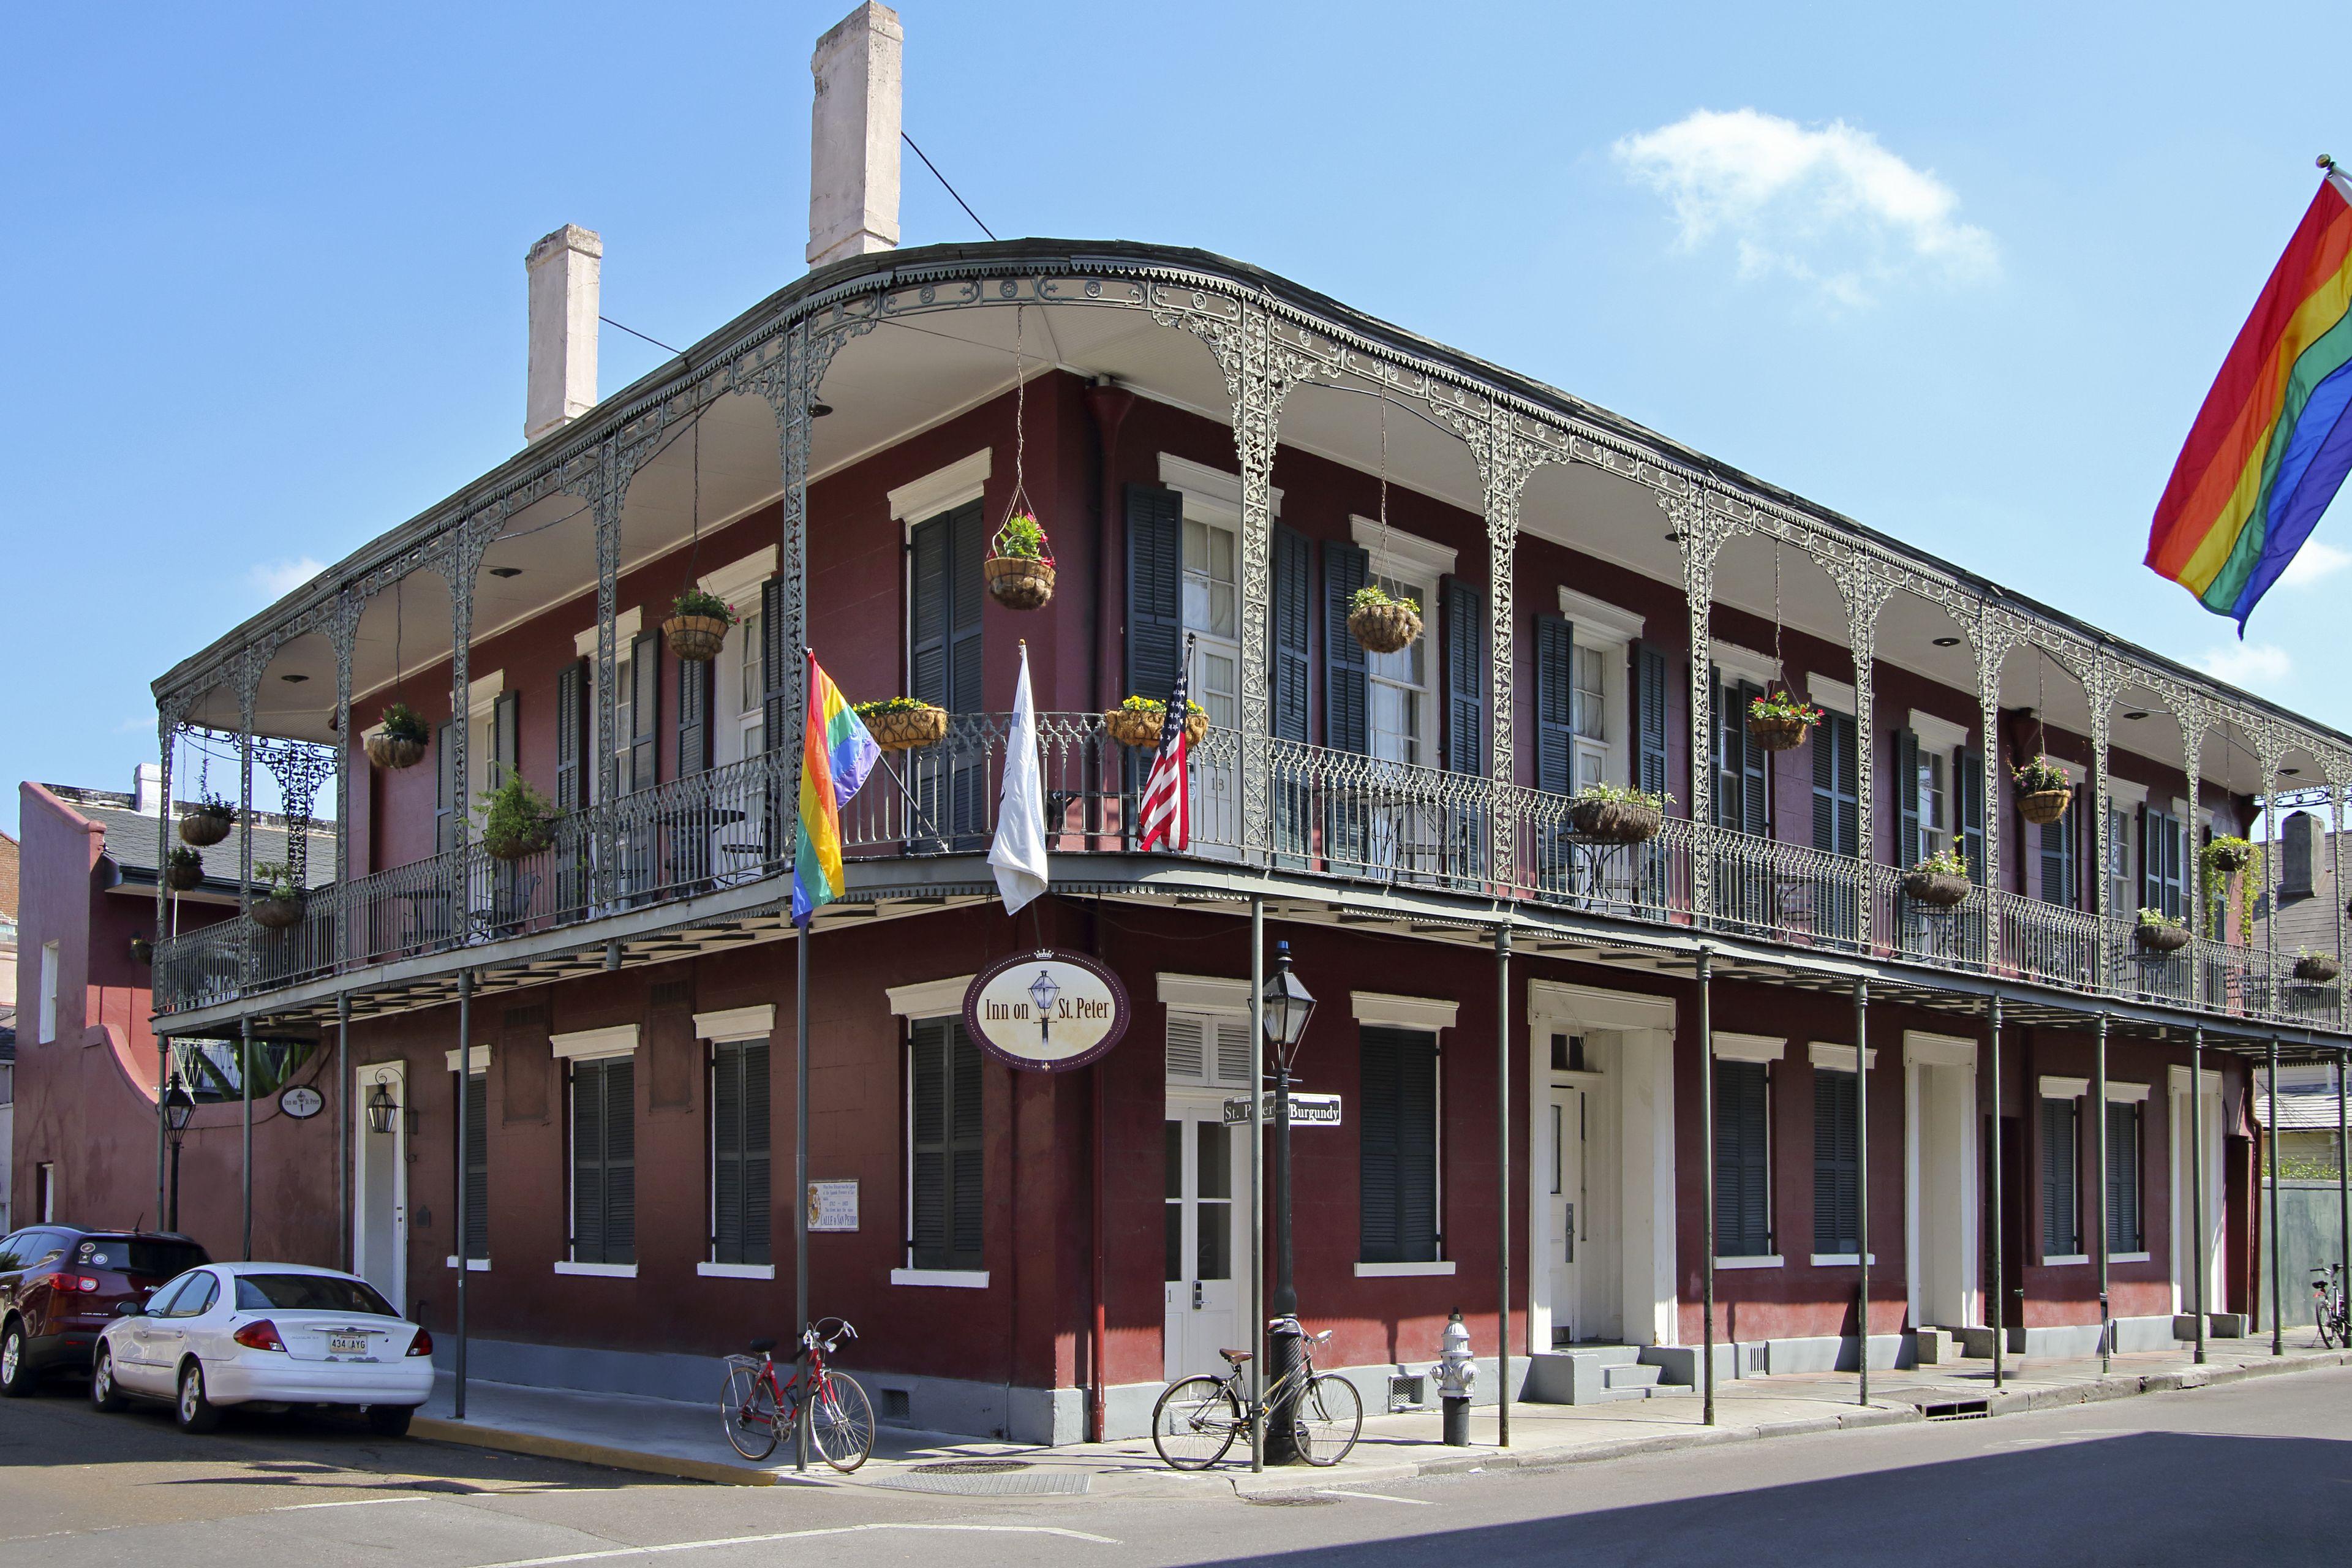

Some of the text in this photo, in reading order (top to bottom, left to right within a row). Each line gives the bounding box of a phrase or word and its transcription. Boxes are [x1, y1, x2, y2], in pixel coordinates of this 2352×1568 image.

[986, 997, 1109, 1020] Inn on St. Peter
[1225, 1103, 1274, 1120] St. Per
[1290, 1103, 1338, 1123] Burgundy
[1167, 1289, 1172, 1303] 1
[332, 1339, 365, 1349] 434 AYG
